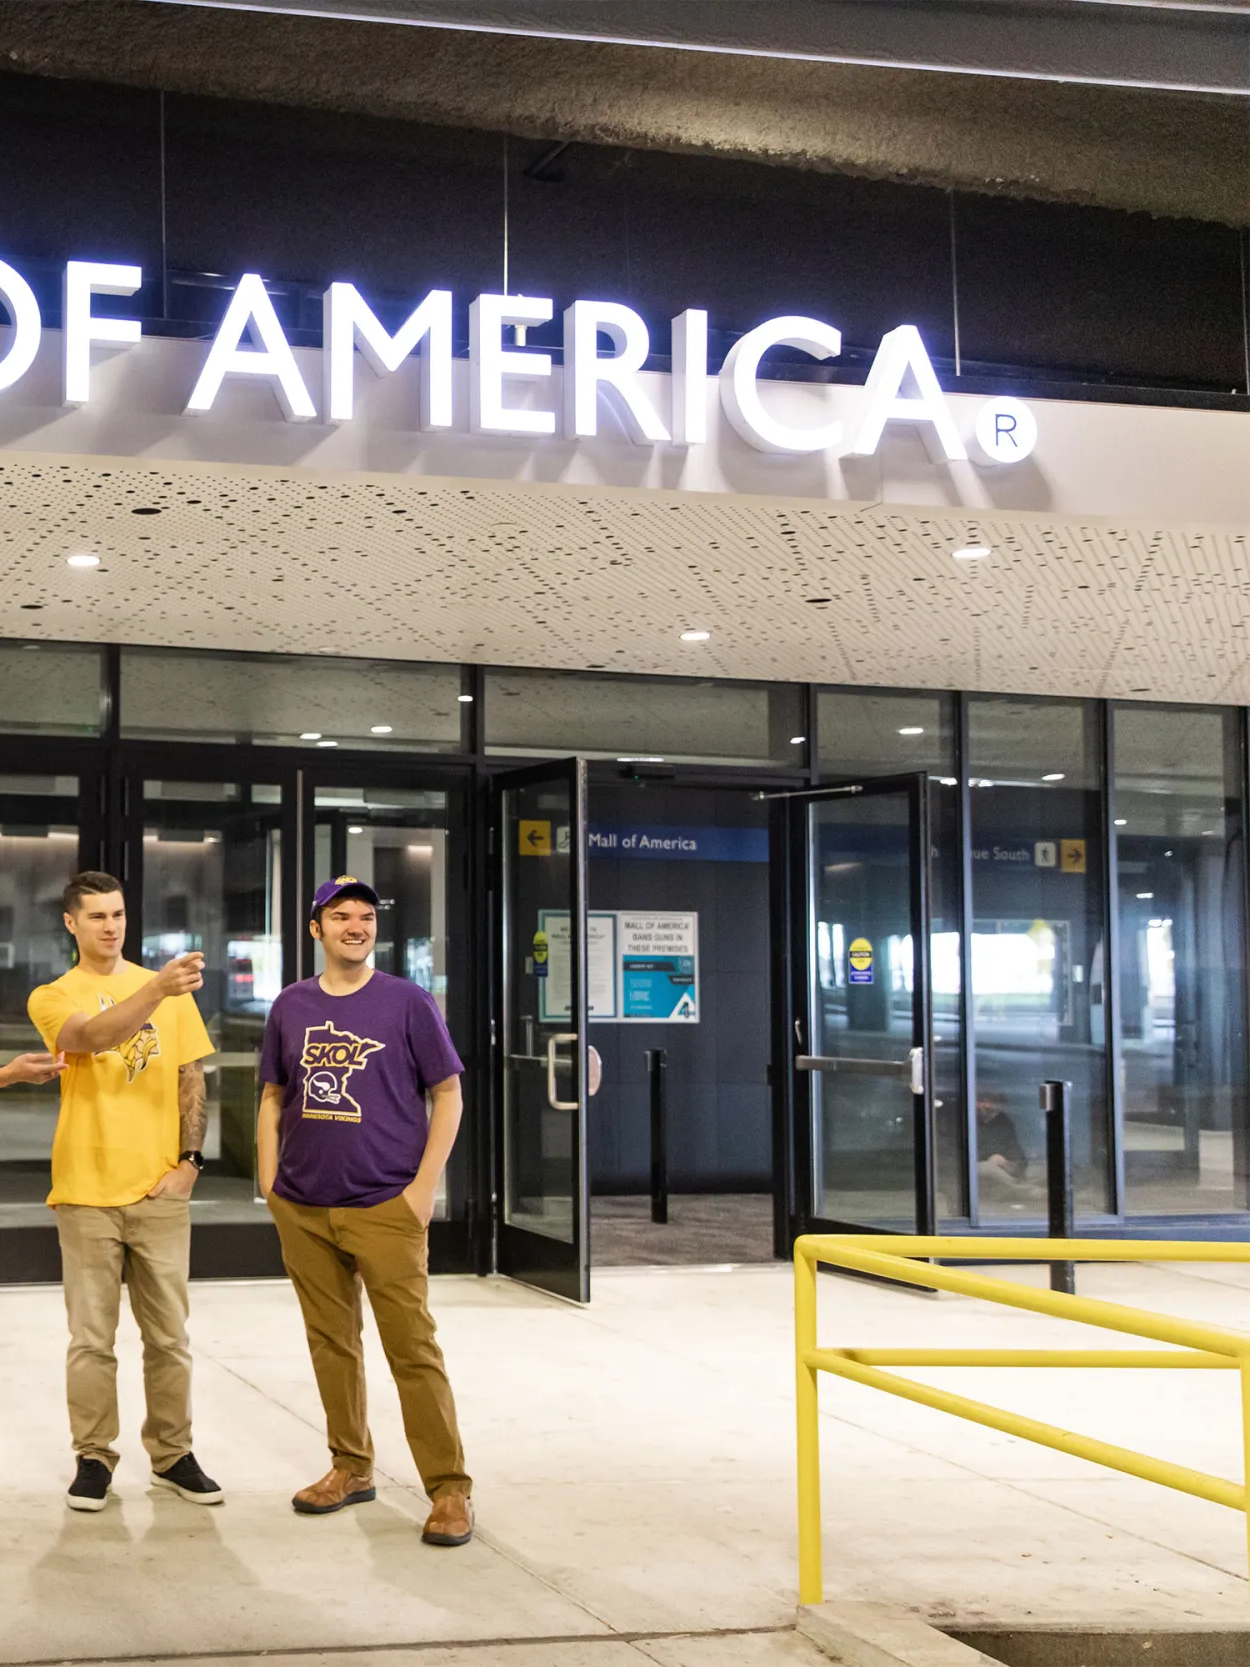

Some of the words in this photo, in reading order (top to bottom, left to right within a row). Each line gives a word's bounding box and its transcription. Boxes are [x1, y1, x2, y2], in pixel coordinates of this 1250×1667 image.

[587, 833, 618, 849] Mall
[621, 834, 637, 849] of
[639, 835, 698, 851] America
[992, 846, 1031, 862] South
[624, 921, 644, 930] MALL
[645, 922, 655, 930] OF
[632, 932, 652, 941] BANS
[654, 933, 674, 941] GUNS
[675, 933, 683, 942] IN
[628, 944, 651, 953] THESE
[652, 944, 688, 953] PREMISES
[304, 1043, 367, 1069] SKOL
[334, 1115, 361, 1123] VIKINGS
